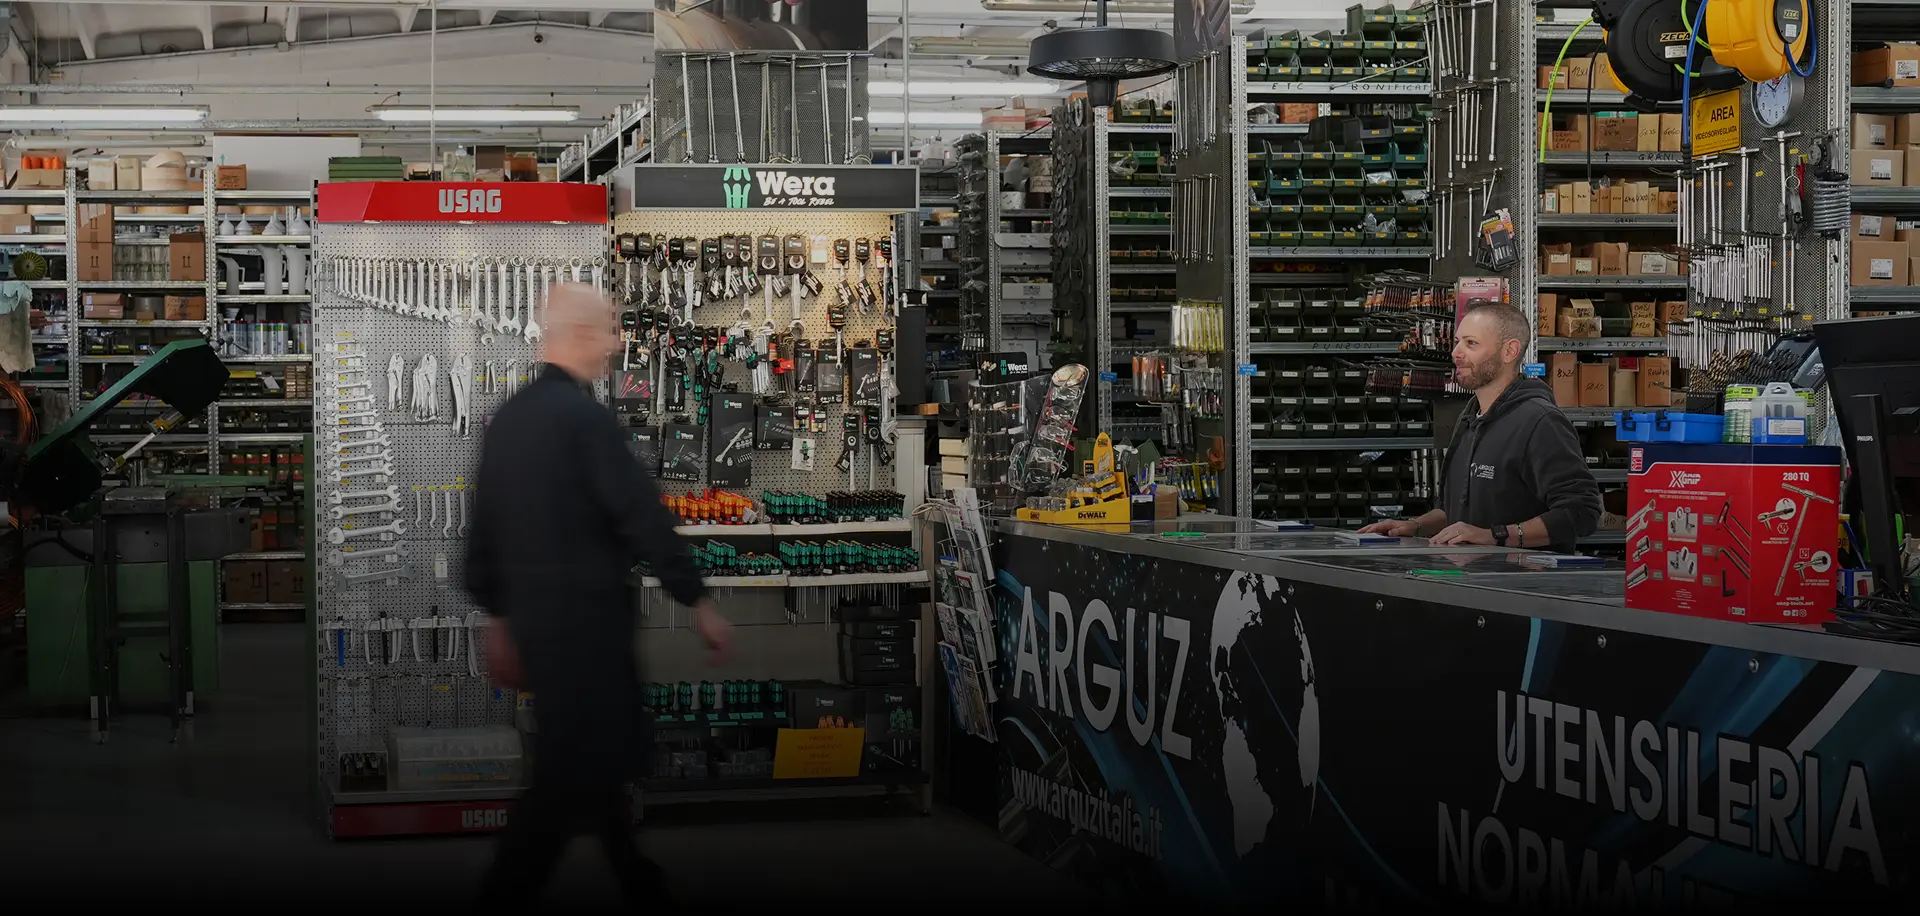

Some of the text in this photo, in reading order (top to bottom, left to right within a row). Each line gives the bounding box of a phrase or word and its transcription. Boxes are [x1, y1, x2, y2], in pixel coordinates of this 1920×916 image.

[1661, 32, 1691, 41] ZECA
[1710, 105, 1735, 122] AREA
[1695, 125, 1738, 141] VIDEOSORVEGLIATA
[1638, 151, 1675, 161] GRANI
[756, 171, 834, 195] Wera
[438, 188, 502, 213] USAG
[1670, 304, 1685, 316] 22
[1782, 472, 1811, 482] 280 TQ
[1012, 585, 1192, 761] ARGUZ
[1496, 689, 1890, 888] UTENSILERIA
[461, 809, 508, 828] USAG
[1011, 765, 1164, 864] www.arguzitalia.it
